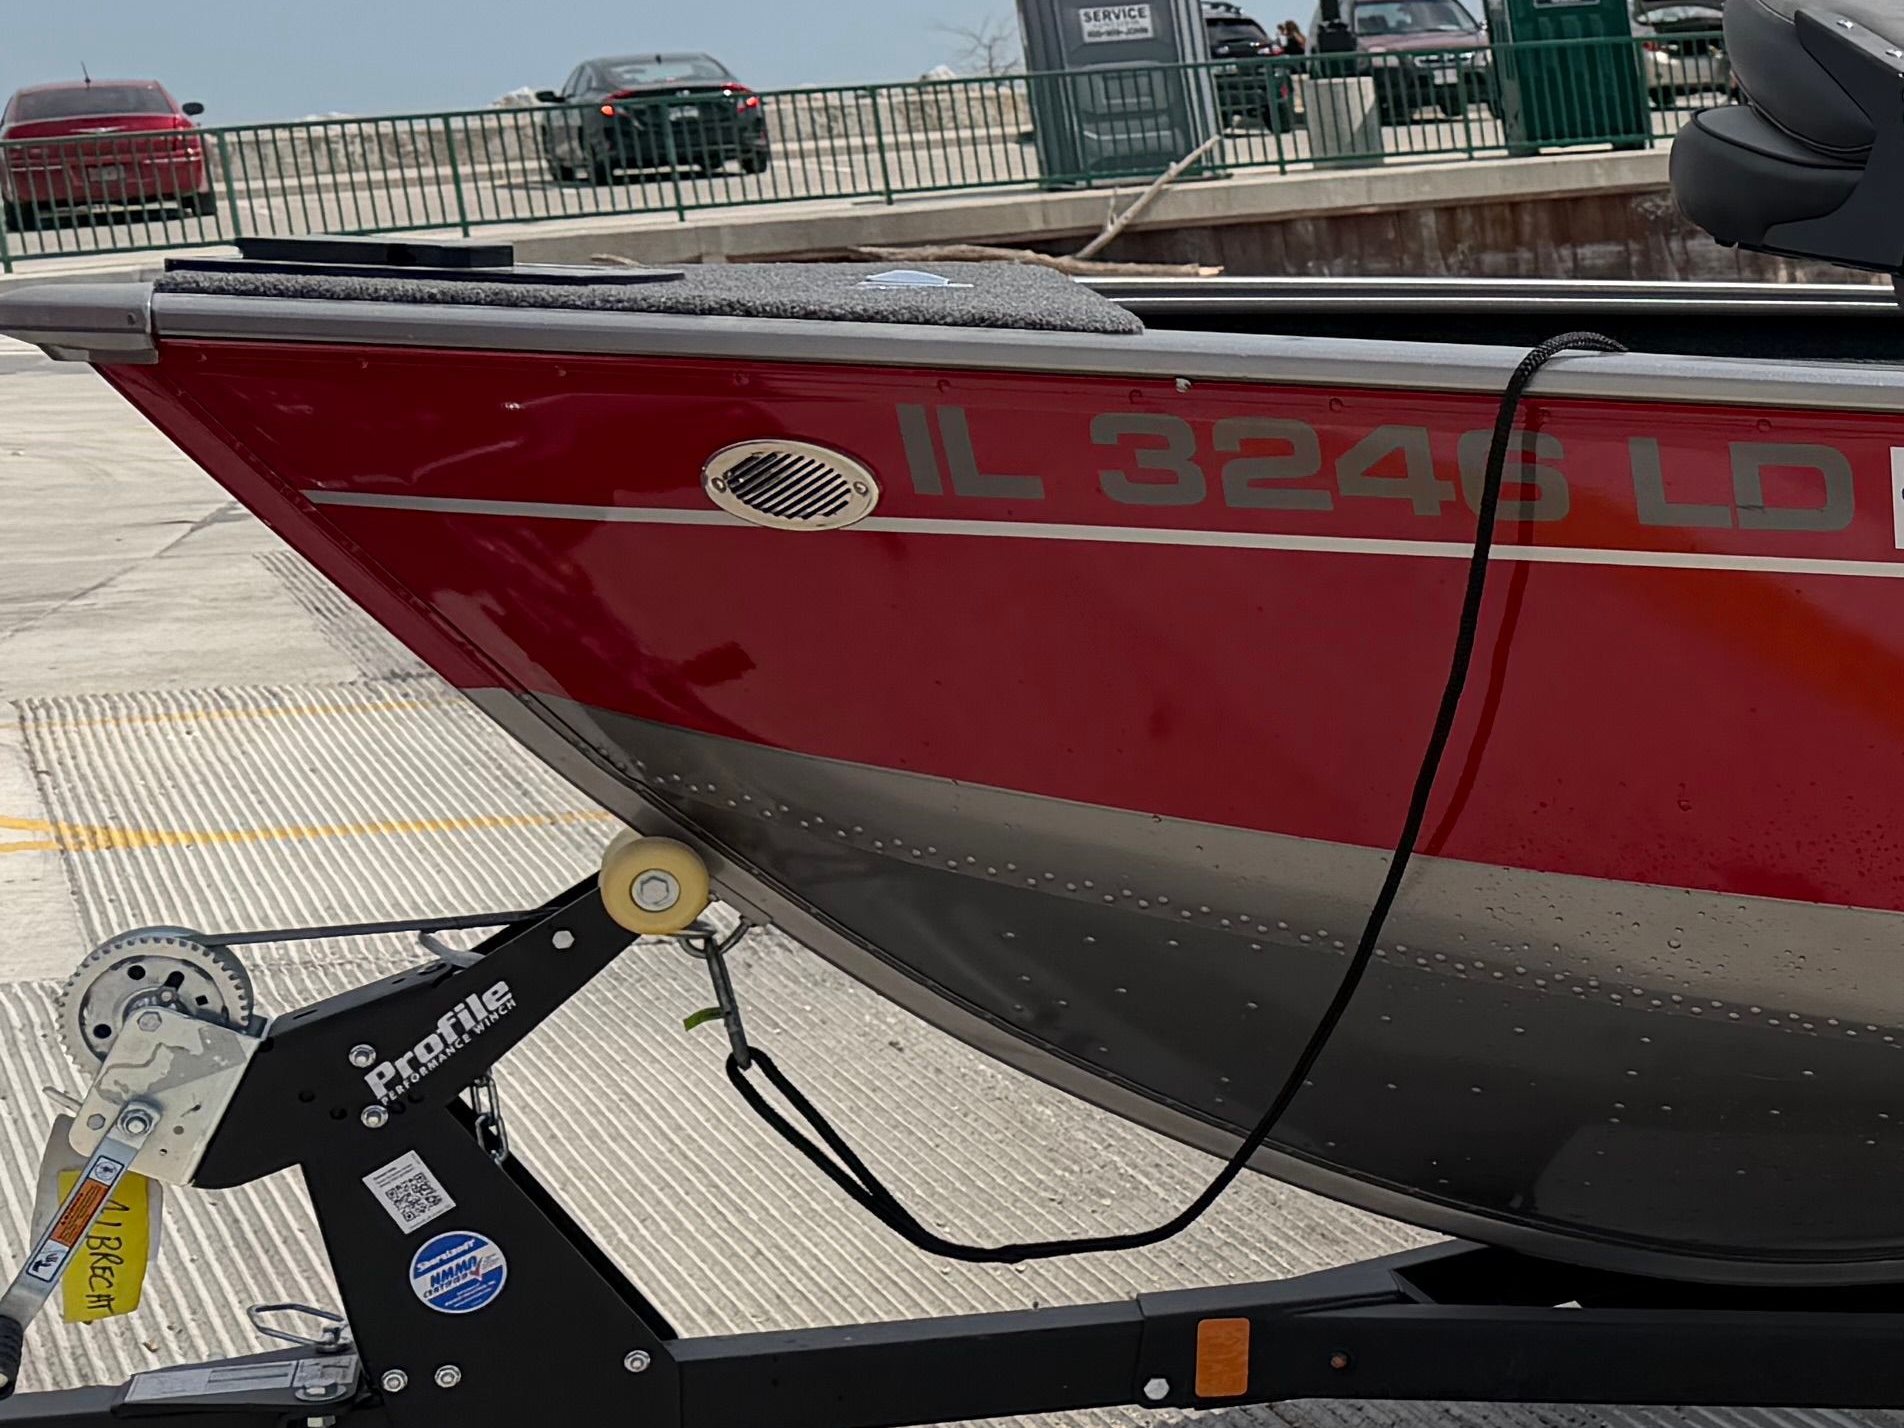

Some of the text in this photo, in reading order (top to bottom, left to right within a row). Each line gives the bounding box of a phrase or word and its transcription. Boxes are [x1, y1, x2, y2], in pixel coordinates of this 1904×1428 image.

[1082, 6, 1148, 24] SERVICE
[896, 403, 1856, 532] IL 3246 LD
[364, 980, 513, 1100] Profile
[380, 998, 517, 1106] PERFORMANCE WINCH
